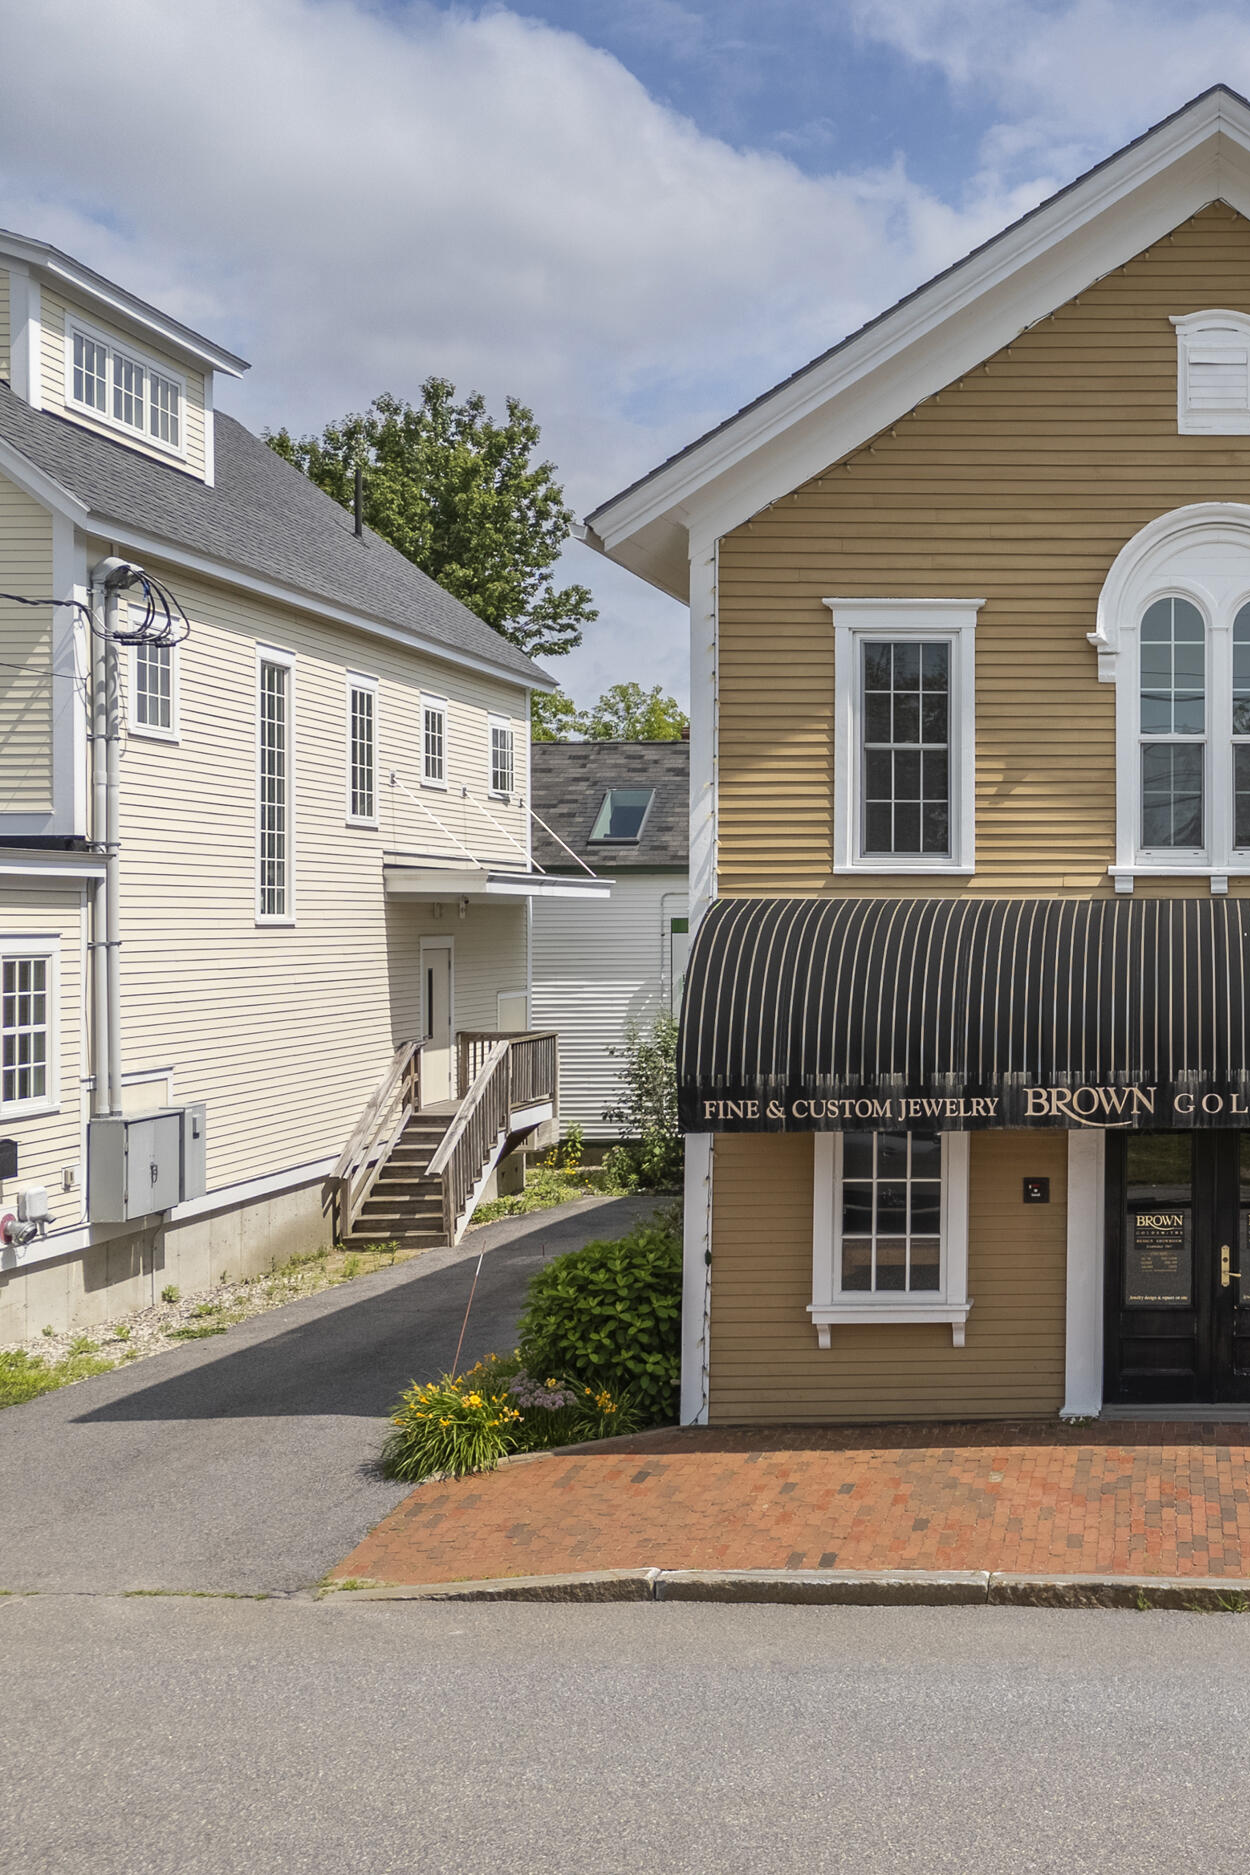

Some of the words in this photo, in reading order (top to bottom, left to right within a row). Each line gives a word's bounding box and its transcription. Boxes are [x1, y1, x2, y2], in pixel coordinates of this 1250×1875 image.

[703, 1100, 760, 1119] FINE
[766, 1100, 786, 1119] &
[792, 1099, 893, 1119] CUSTOM
[898, 1098, 999, 1121] JEWELRY
[1023, 1087, 1157, 1127] BROWN
[1136, 1215, 1183, 1230] BROWN
